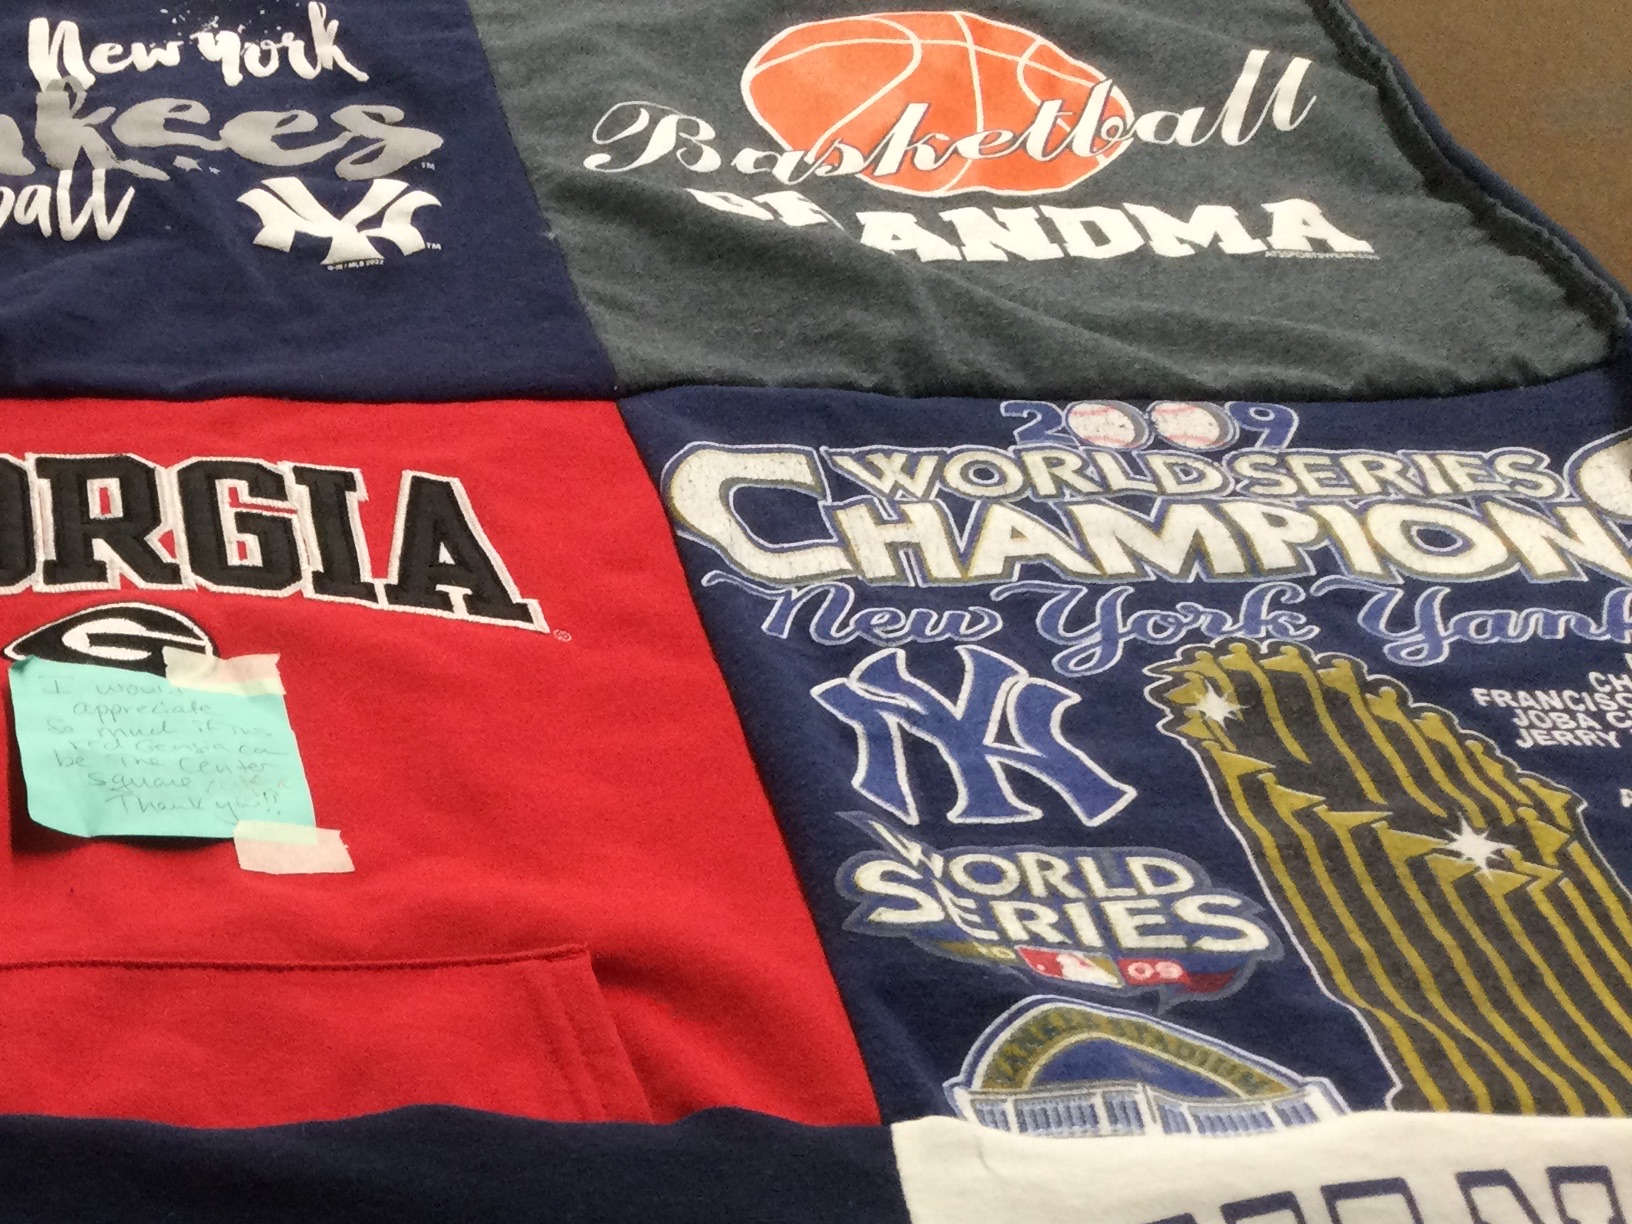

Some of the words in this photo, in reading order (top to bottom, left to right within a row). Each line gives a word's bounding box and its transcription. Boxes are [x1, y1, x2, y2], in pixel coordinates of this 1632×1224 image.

[583, 50, 1319, 185] Basketball
[820, 445, 1236, 501] WORLD
[1232, 447, 1564, 499] SERIES
[702, 569, 1004, 646] New
[990, 577, 1322, 678] York
[1512, 708, 1603, 730] JOBA
[1515, 728, 1622, 749] JERRY
[853, 859, 1270, 953] SERIES
